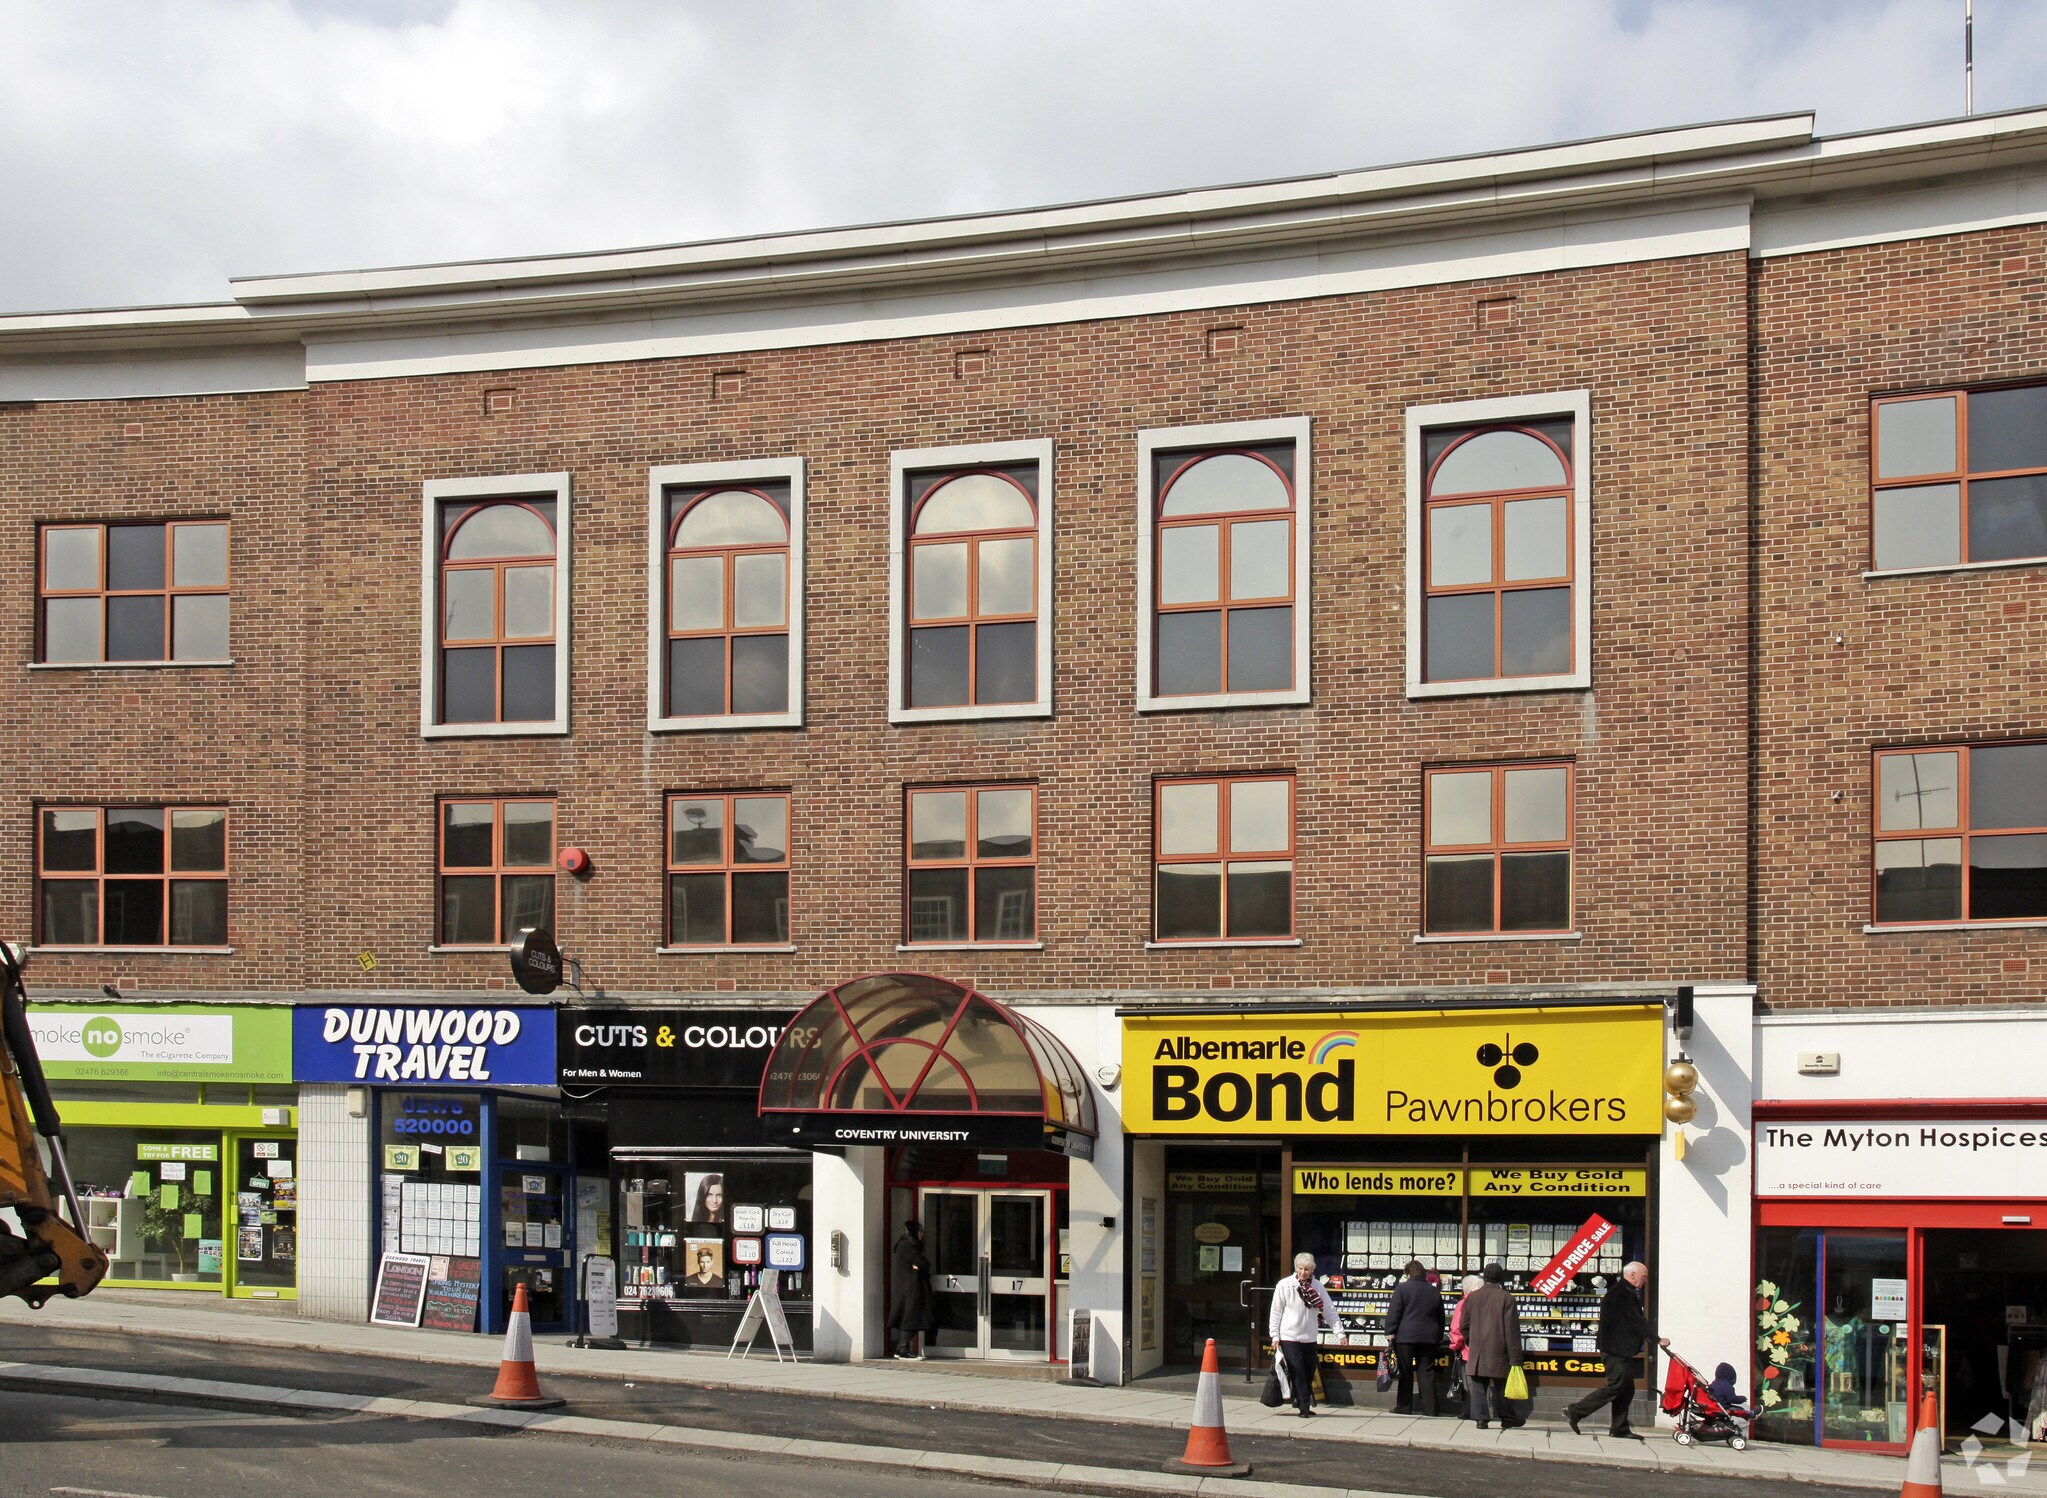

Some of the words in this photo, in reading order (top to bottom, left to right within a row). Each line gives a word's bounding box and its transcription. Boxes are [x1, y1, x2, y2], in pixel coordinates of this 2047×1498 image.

[359, 952, 375, 969] H
[531, 949, 546, 960] CUTS
[528, 957, 556, 974] COLOURS
[323, 1008, 521, 1046] DUNWOOD
[30, 1025, 80, 1044] moke
[87, 1030, 118, 1045] no
[574, 1025, 648, 1047] CUTS
[656, 1026, 676, 1048] &
[1154, 1036, 1306, 1060] Albemarle
[156, 1051, 193, 1060] eCigarette
[195, 1051, 230, 1061] Company
[353, 1044, 491, 1082] TRAVEL
[75, 1068, 99, 1076] 02476
[101, 1068, 129, 1076] 629366
[157, 1069, 284, 1079] info@centralsmokenosmoke.com
[563, 1069, 577, 1077] For
[578, 1069, 598, 1077] Men
[599, 1069, 607, 1077] &
[608, 1069, 642, 1078] Women
[1152, 1059, 1355, 1122] Bond
[1386, 1089, 1627, 1122] Pawnbrokers
[393, 1118, 473, 1135] 520000
[835, 1129, 897, 1139] COVENTRY
[899, 1130, 969, 1141] UNIVERSITY
[1767, 1128, 1813, 1147] The
[1823, 1128, 1910, 1151] Myton
[1920, 1127, 2047, 1151] Hospices
[171, 1146, 212, 1159] FREE
[396, 1155, 407, 1163] 20
[457, 1155, 468, 1164] 20
[1197, 1175, 1221, 1183] Buy
[1224, 1175, 1253, 1183] Gold
[1301, 1172, 1340, 1190] Who
[1346, 1172, 1394, 1191] lends
[1399, 1173, 1457, 1191] more?
[1490, 1169, 1522, 1180] We
[1529, 1169, 1569, 1181] Buy
[1575, 1169, 1624, 1180] Gold
[1171, 1182, 1194, 1190] Any
[1198, 1182, 1257, 1190] Condition
[1483, 1182, 1524, 1194] Any
[1530, 1181, 1631, 1193] Condition
[1788, 1182, 1822, 1190] special
[1825, 1181, 1845, 1189] kind
[1848, 1181, 1857, 1189] of
[1591, 1221, 1612, 1243] SALE
[1540, 1266, 1566, 1295] HALF
[1562, 1239, 1594, 1271] PRICE
[946, 1278, 958, 1288] 17
[1011, 1280, 1024, 1291] 17
[624, 1286, 638, 1296] 024
[1318, 1353, 1377, 1366] eques
[1565, 1359, 1606, 1373] Cas
